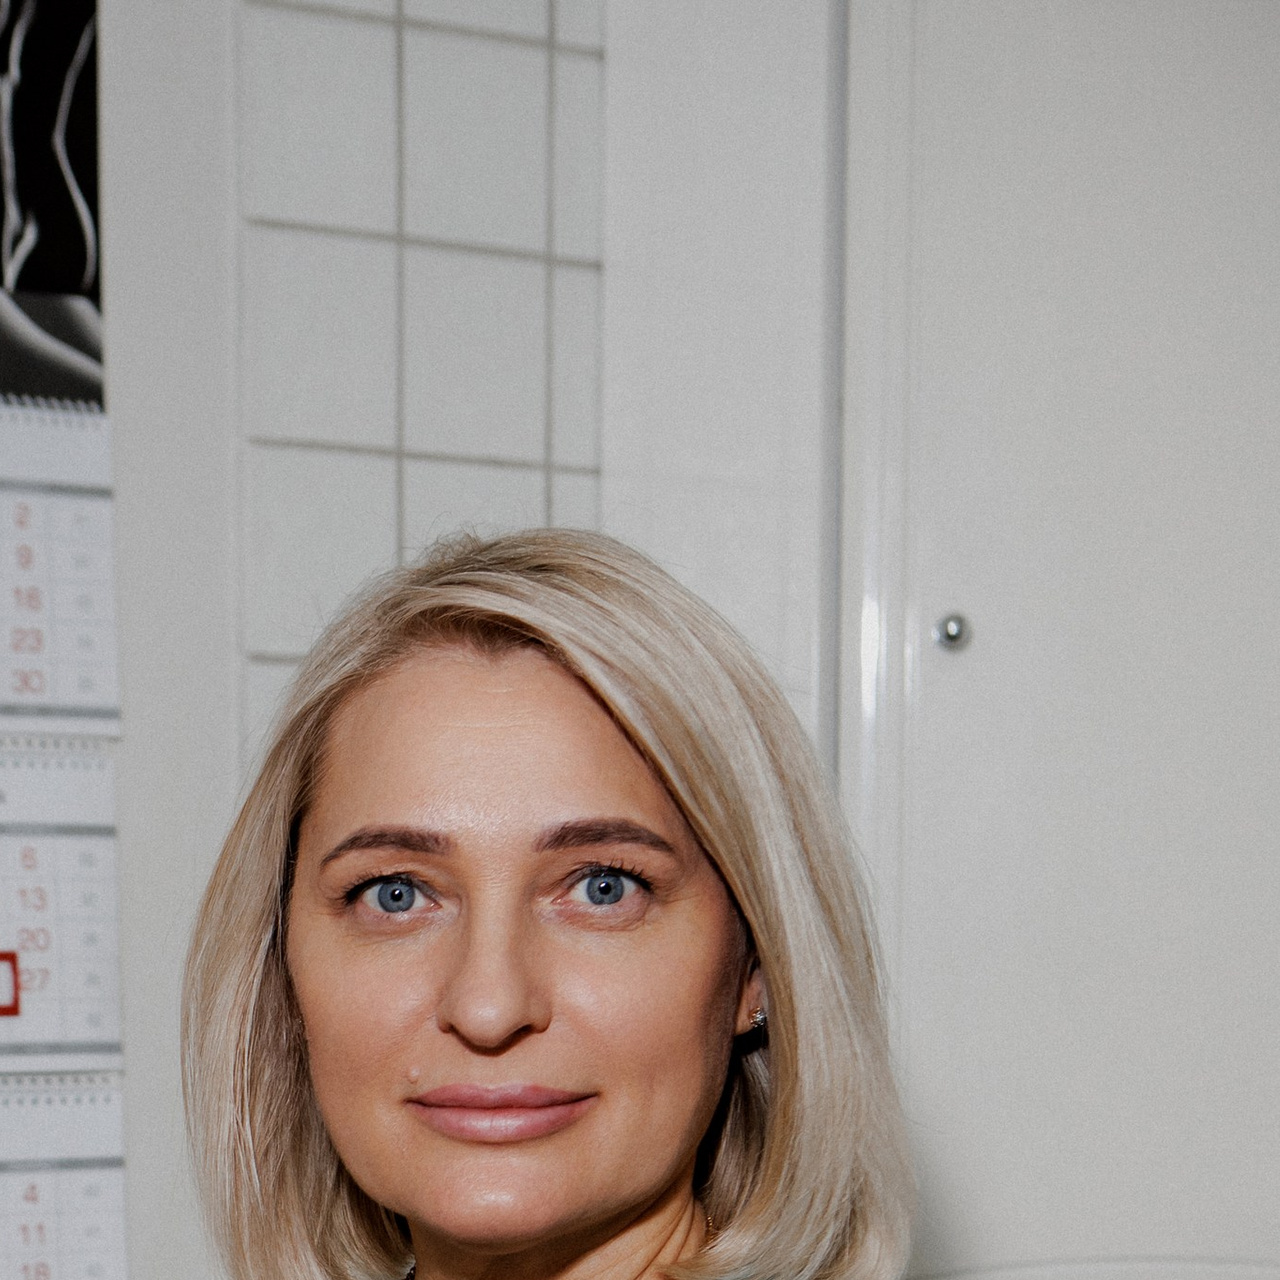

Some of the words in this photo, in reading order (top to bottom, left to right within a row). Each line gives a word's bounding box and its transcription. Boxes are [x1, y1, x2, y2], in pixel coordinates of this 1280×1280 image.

[12, 586, 43, 611] 16
[10, 628, 44, 653] 23
[12, 670, 44, 692] 30
[17, 887, 48, 911] 13
[17, 927, 52, 951] 20
[17, 968, 51, 992] 27
[21, 1184, 40, 1204] 4
[18, 1223, 46, 1243] 11
